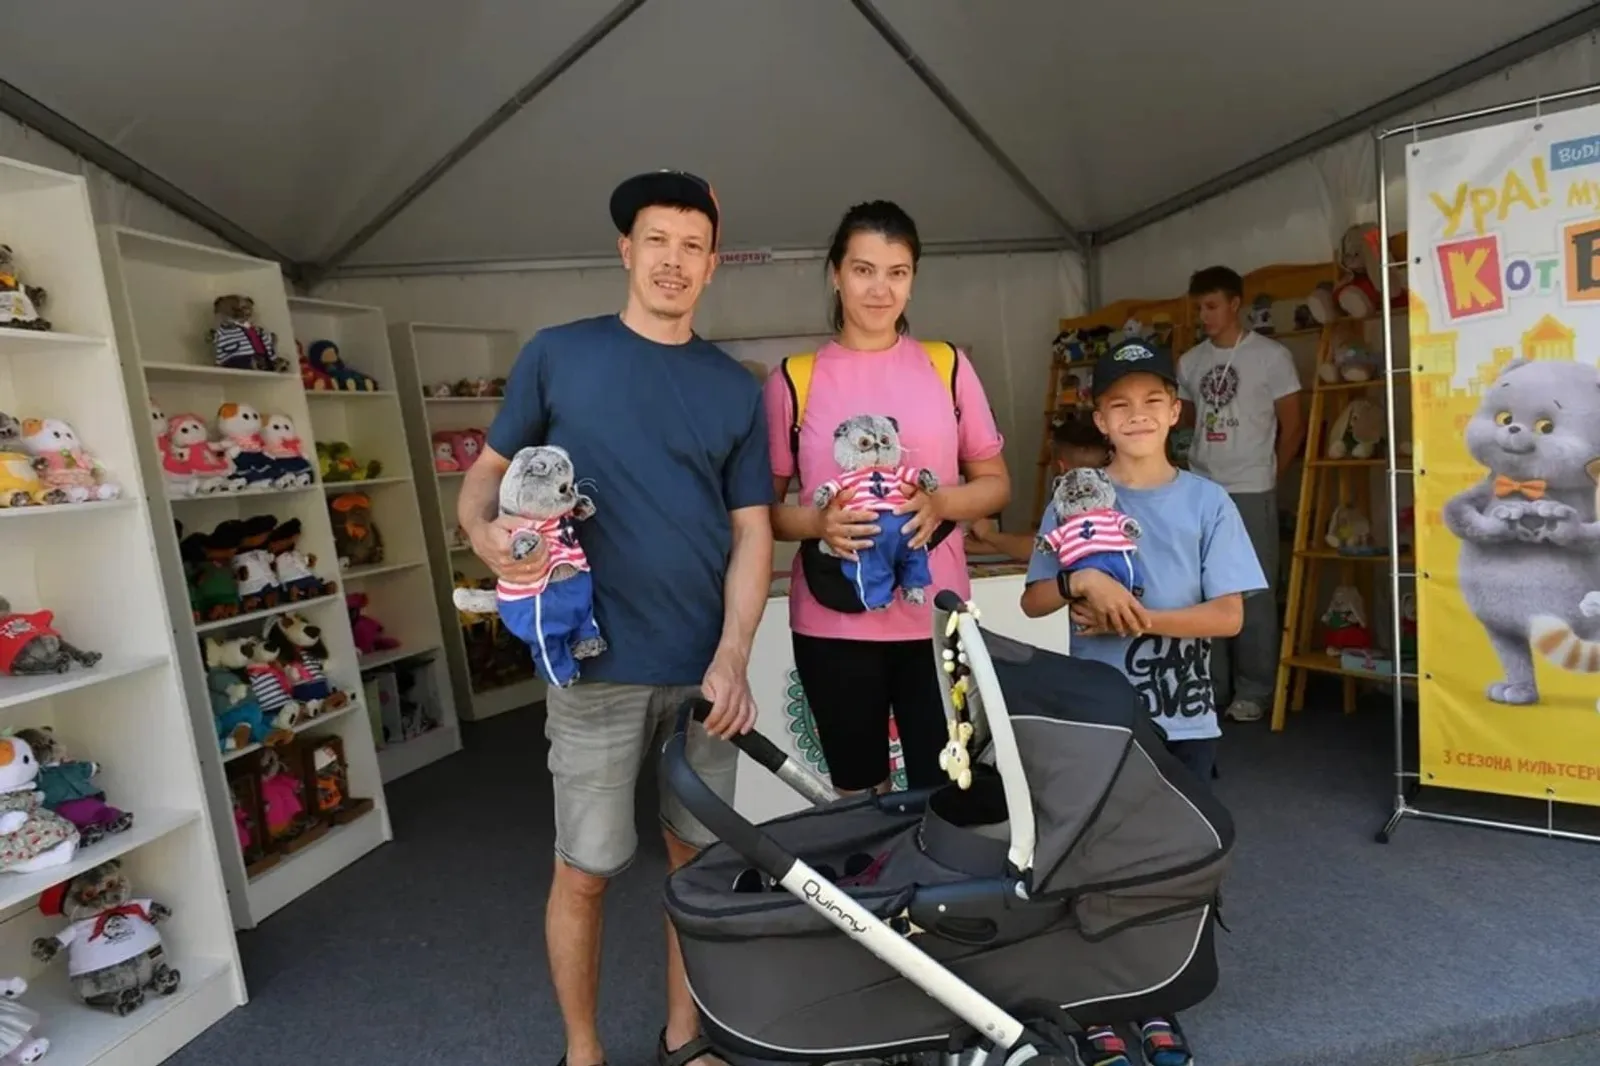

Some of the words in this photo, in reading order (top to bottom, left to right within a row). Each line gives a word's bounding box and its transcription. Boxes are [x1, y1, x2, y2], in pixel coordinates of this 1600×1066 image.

[1429, 157, 1552, 238] УРА!
[1443, 750, 1451, 765] 3
[1456, 752, 1512, 773] СЕЗОНА
[802, 879, 867, 933] Quinny
